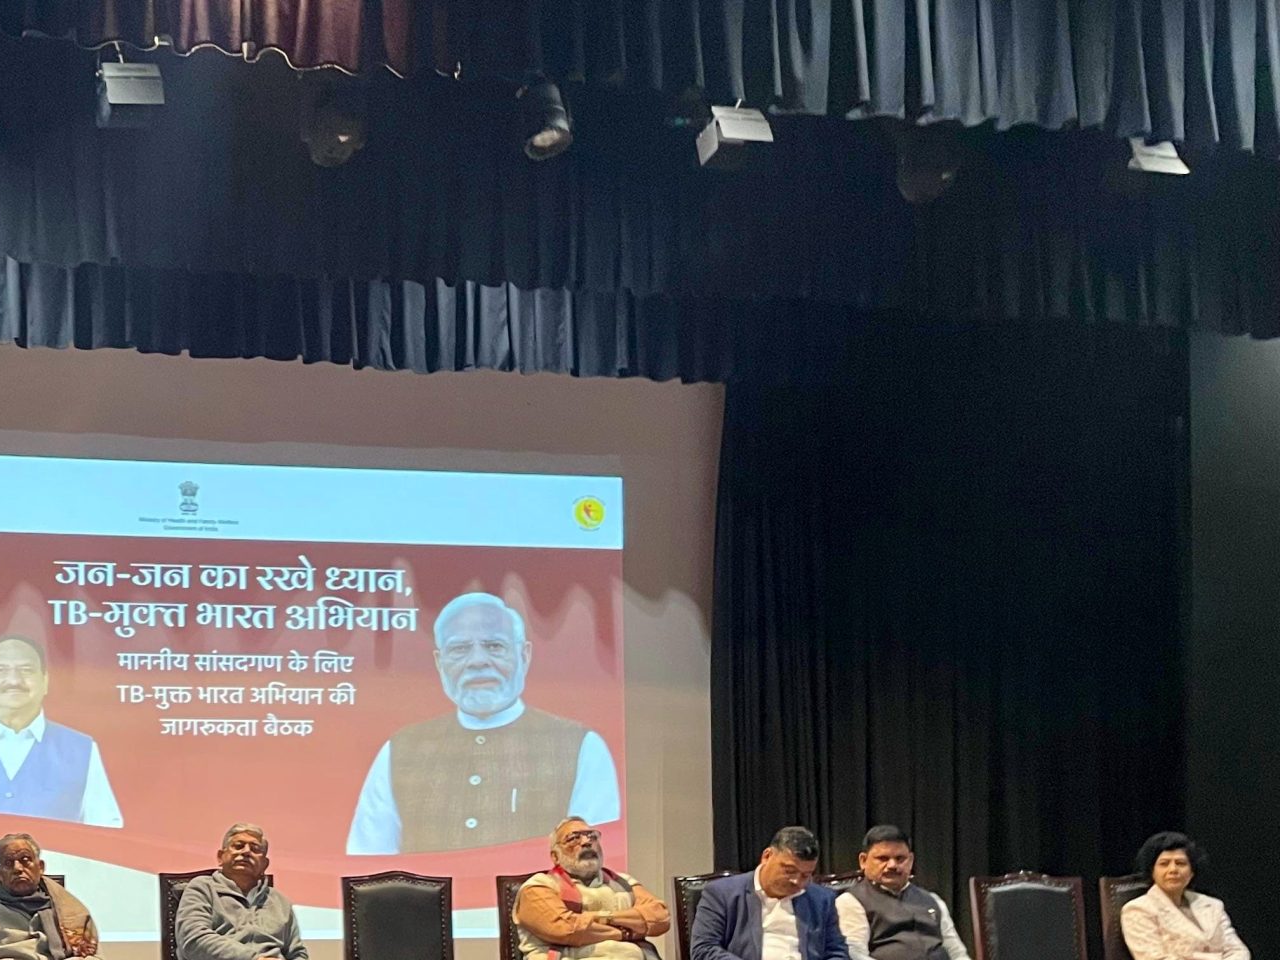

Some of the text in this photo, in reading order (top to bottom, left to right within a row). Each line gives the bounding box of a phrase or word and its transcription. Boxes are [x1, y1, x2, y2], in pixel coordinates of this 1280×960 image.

[53, 554, 413, 597] जन-जन का रखे ध्यान,
[47, 596, 420, 638] TB-मुक्त भारत अभियान
[117, 647, 355, 673] माननीय सांसदगण के लिए
[116, 681, 357, 710] TB-मुक्त भारत अभियान की
[262, 713, 315, 737] बैठक
